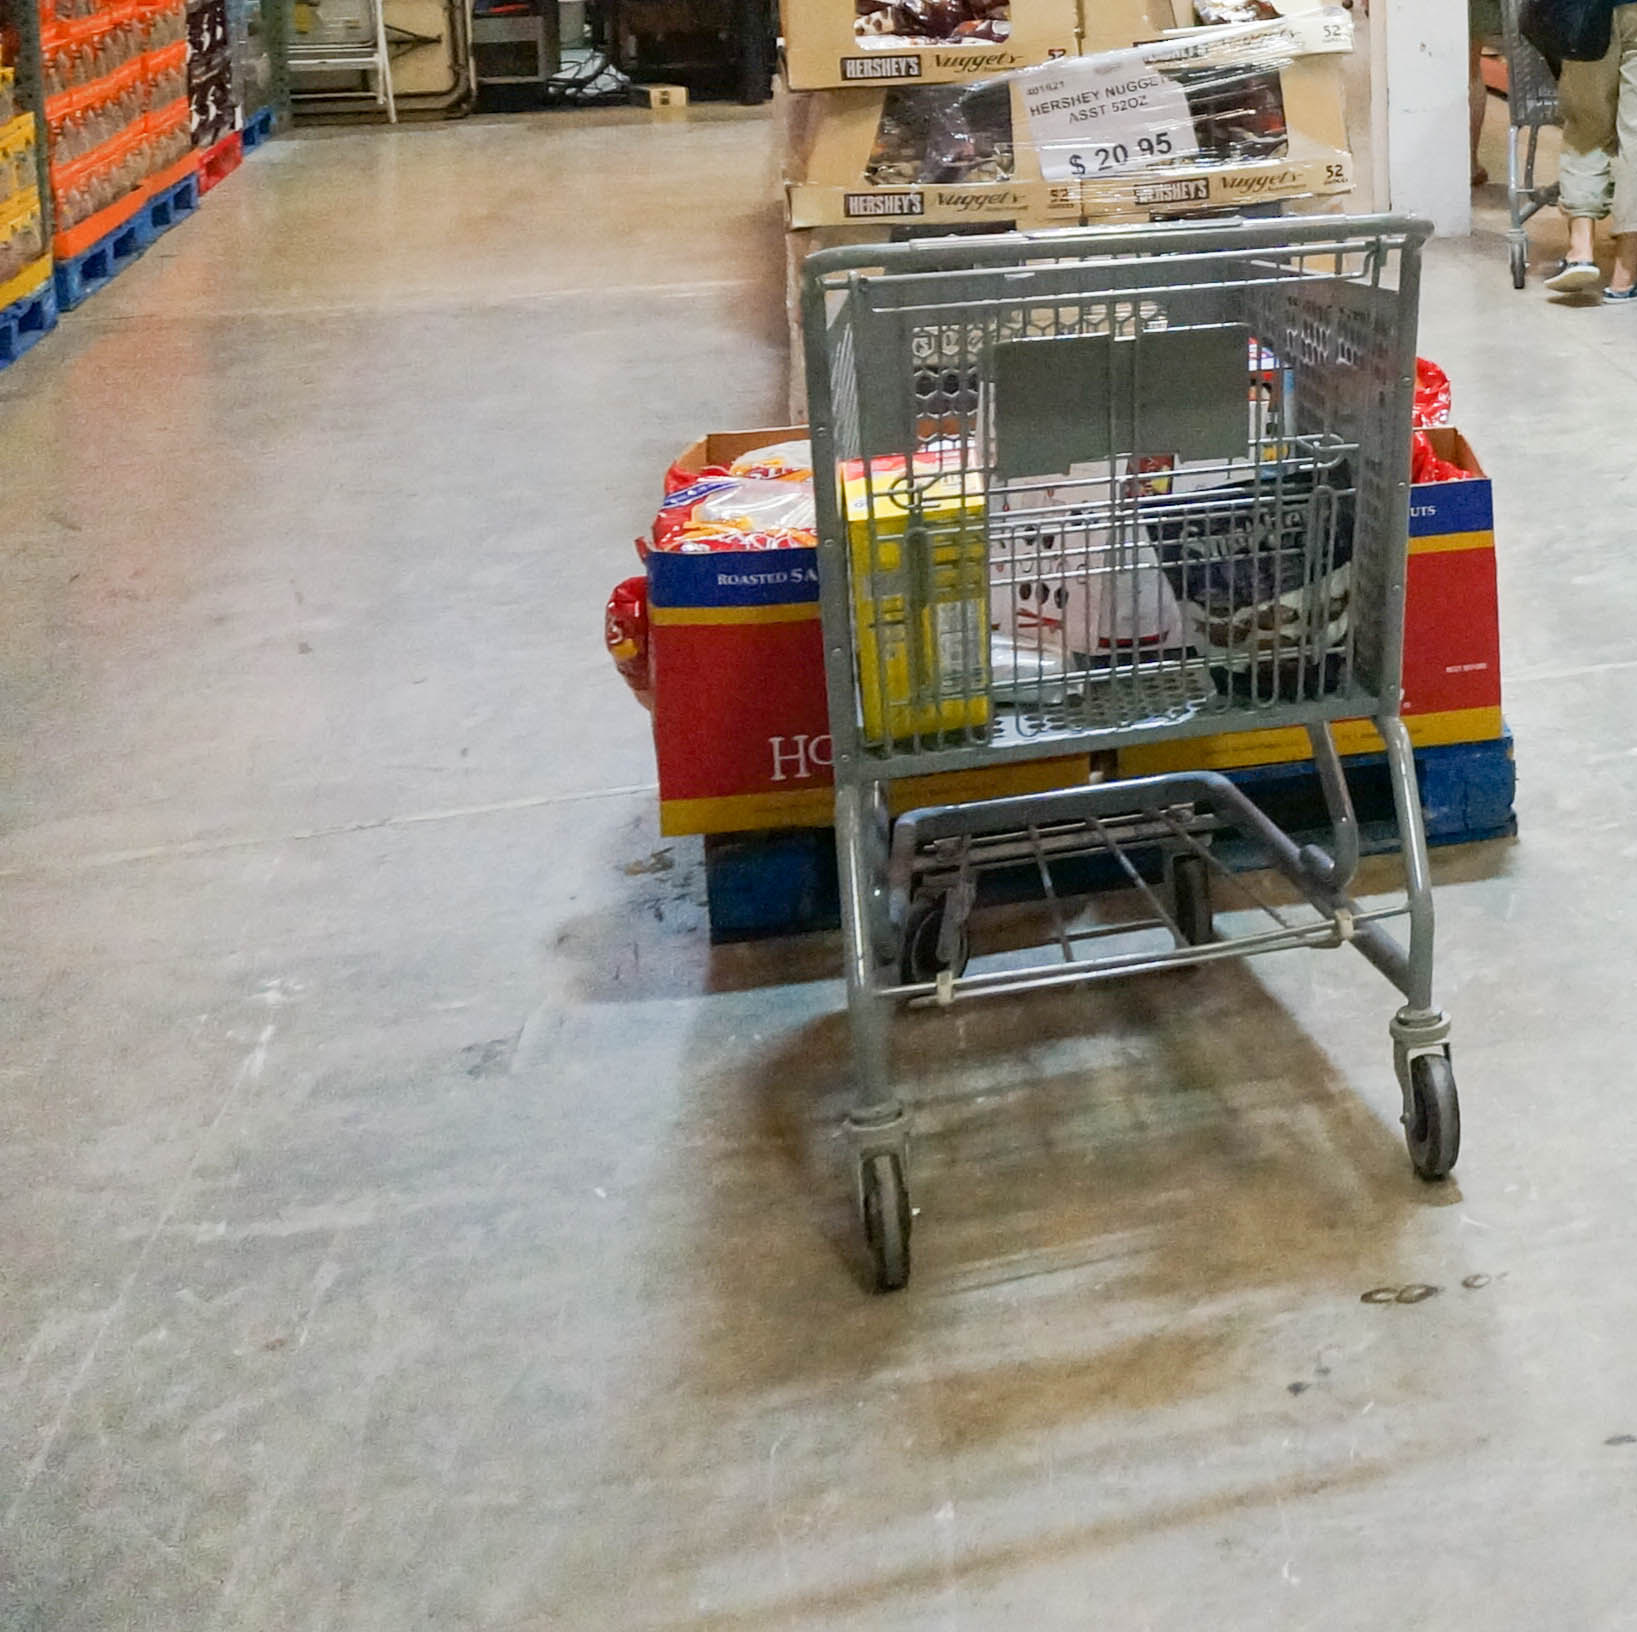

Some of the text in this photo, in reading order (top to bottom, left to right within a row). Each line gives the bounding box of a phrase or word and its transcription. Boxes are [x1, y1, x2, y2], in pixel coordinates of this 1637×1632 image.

[1322, 24, 1343, 38] 52
[844, 57, 920, 79] HERSHEY'S
[1029, 91, 1099, 117] HERSHEY
[1069, 95, 1149, 124] ASST 52OZ
[1069, 132, 1173, 175] $ 20 95
[1325, 164, 1344, 180] 52
[847, 195, 923, 215] HERSHEY'S
[716, 570, 788, 587] ROASTED
